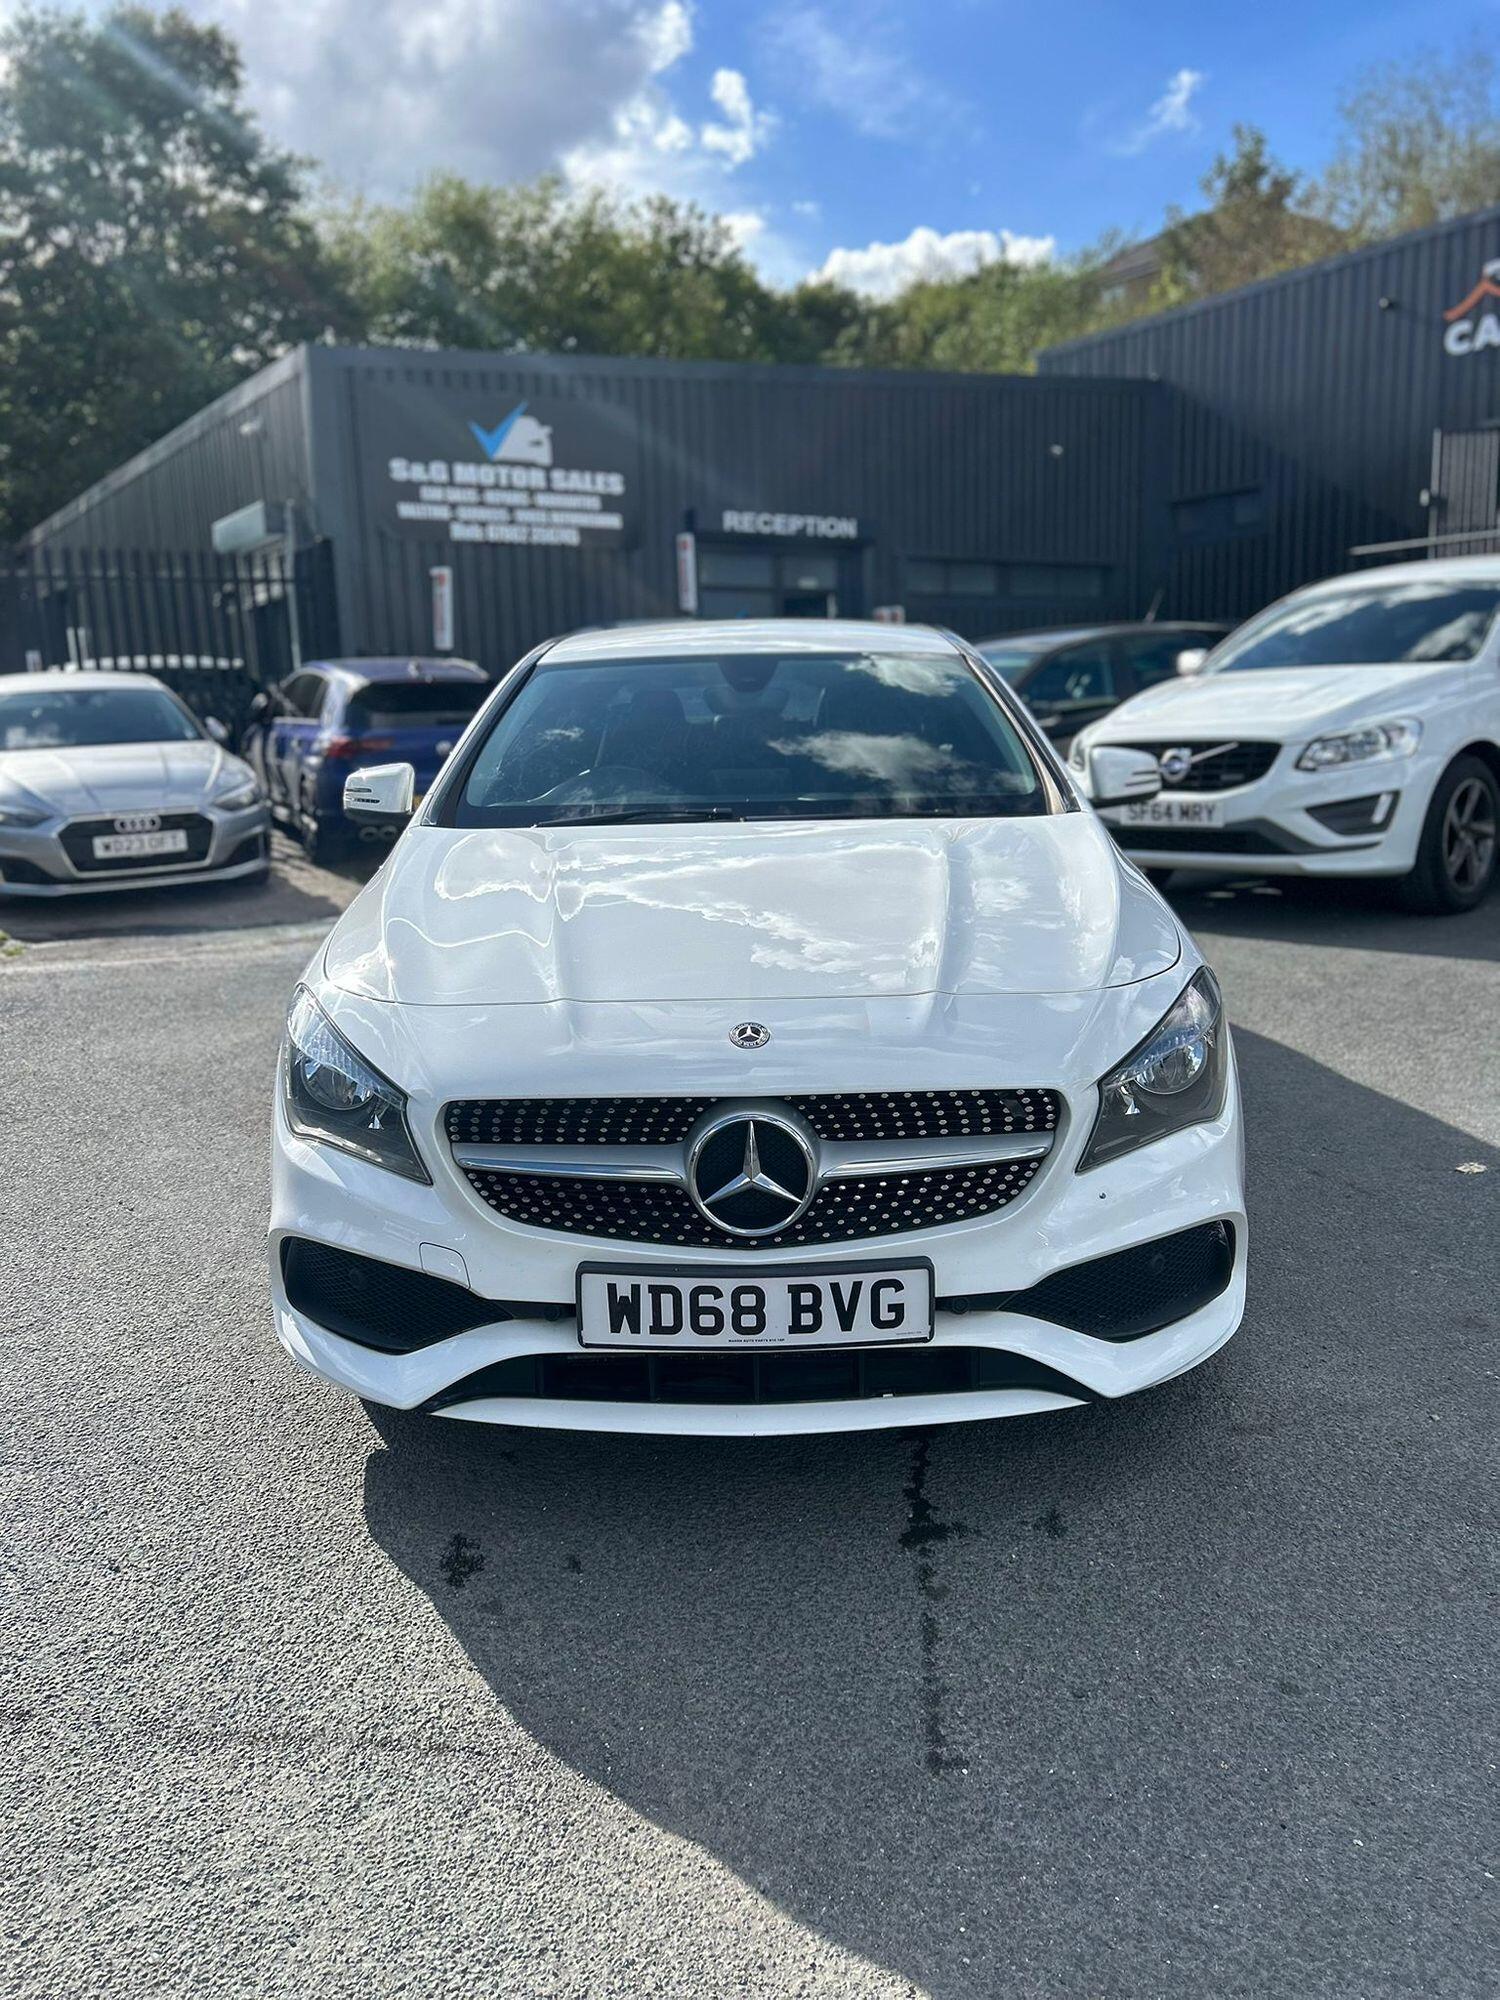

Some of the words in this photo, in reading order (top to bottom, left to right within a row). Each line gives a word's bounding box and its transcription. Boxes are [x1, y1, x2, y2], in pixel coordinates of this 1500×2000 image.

[452, 463, 547, 489] MOTOR
[550, 468, 625, 495] SALES
[722, 510, 858, 539] RECEPTION
[607, 1282, 766, 1336] WD68
[788, 1278, 905, 1335] BVG
